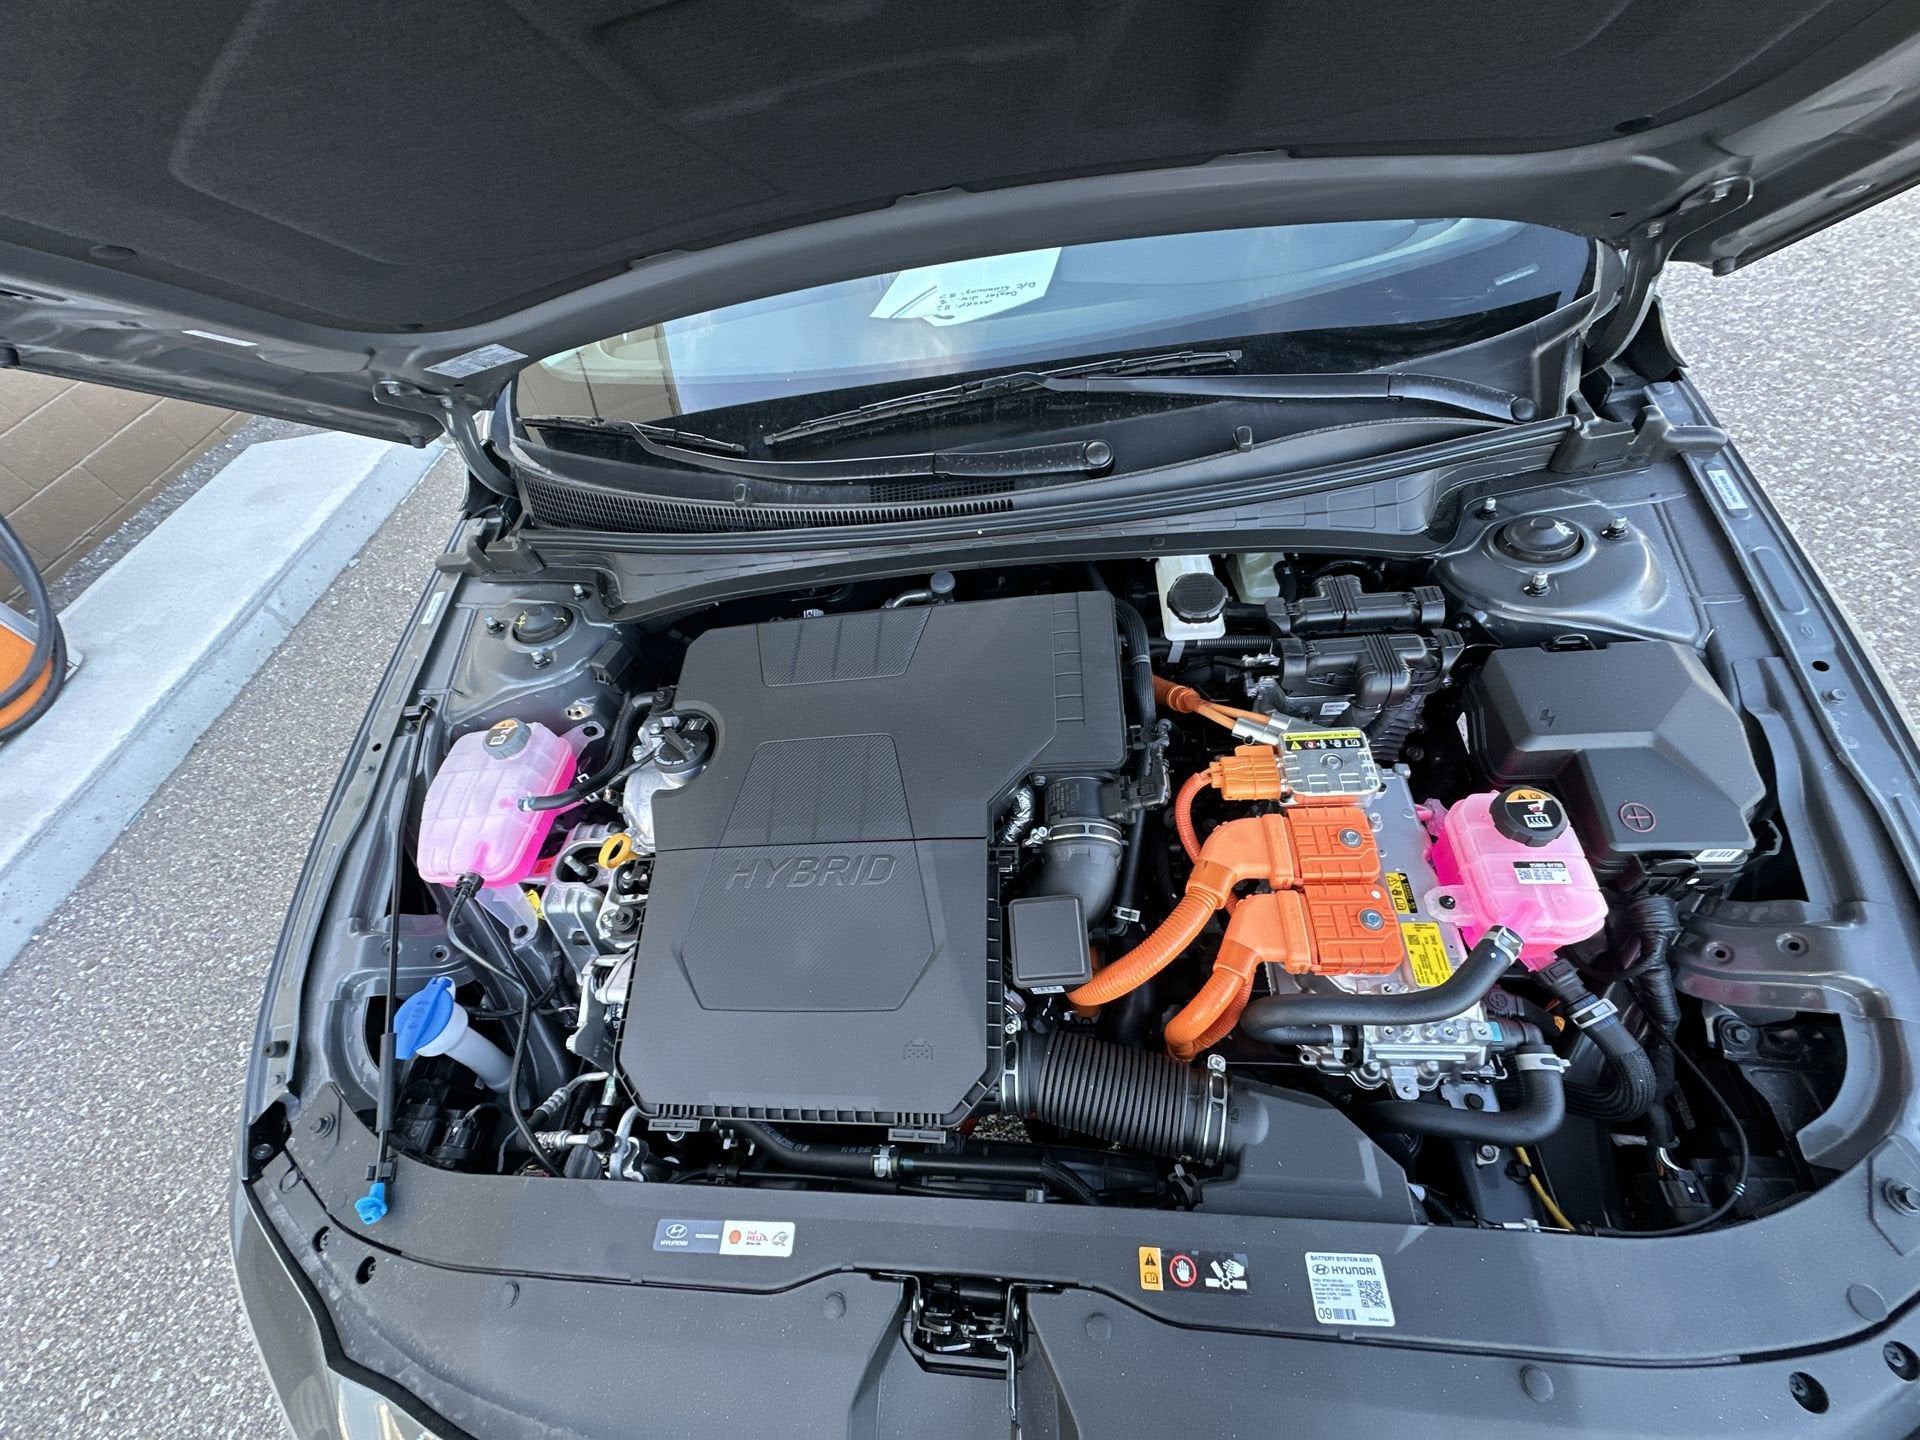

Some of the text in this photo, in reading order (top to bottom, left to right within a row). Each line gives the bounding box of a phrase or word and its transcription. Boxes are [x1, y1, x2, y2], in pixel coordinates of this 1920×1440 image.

[725, 854, 896, 889] HYBRID
[660, 1239, 689, 1247] HYUNDAI
[1331, 1266, 1377, 1276] HYUNDAI
[1318, 1307, 1333, 1320] 09
